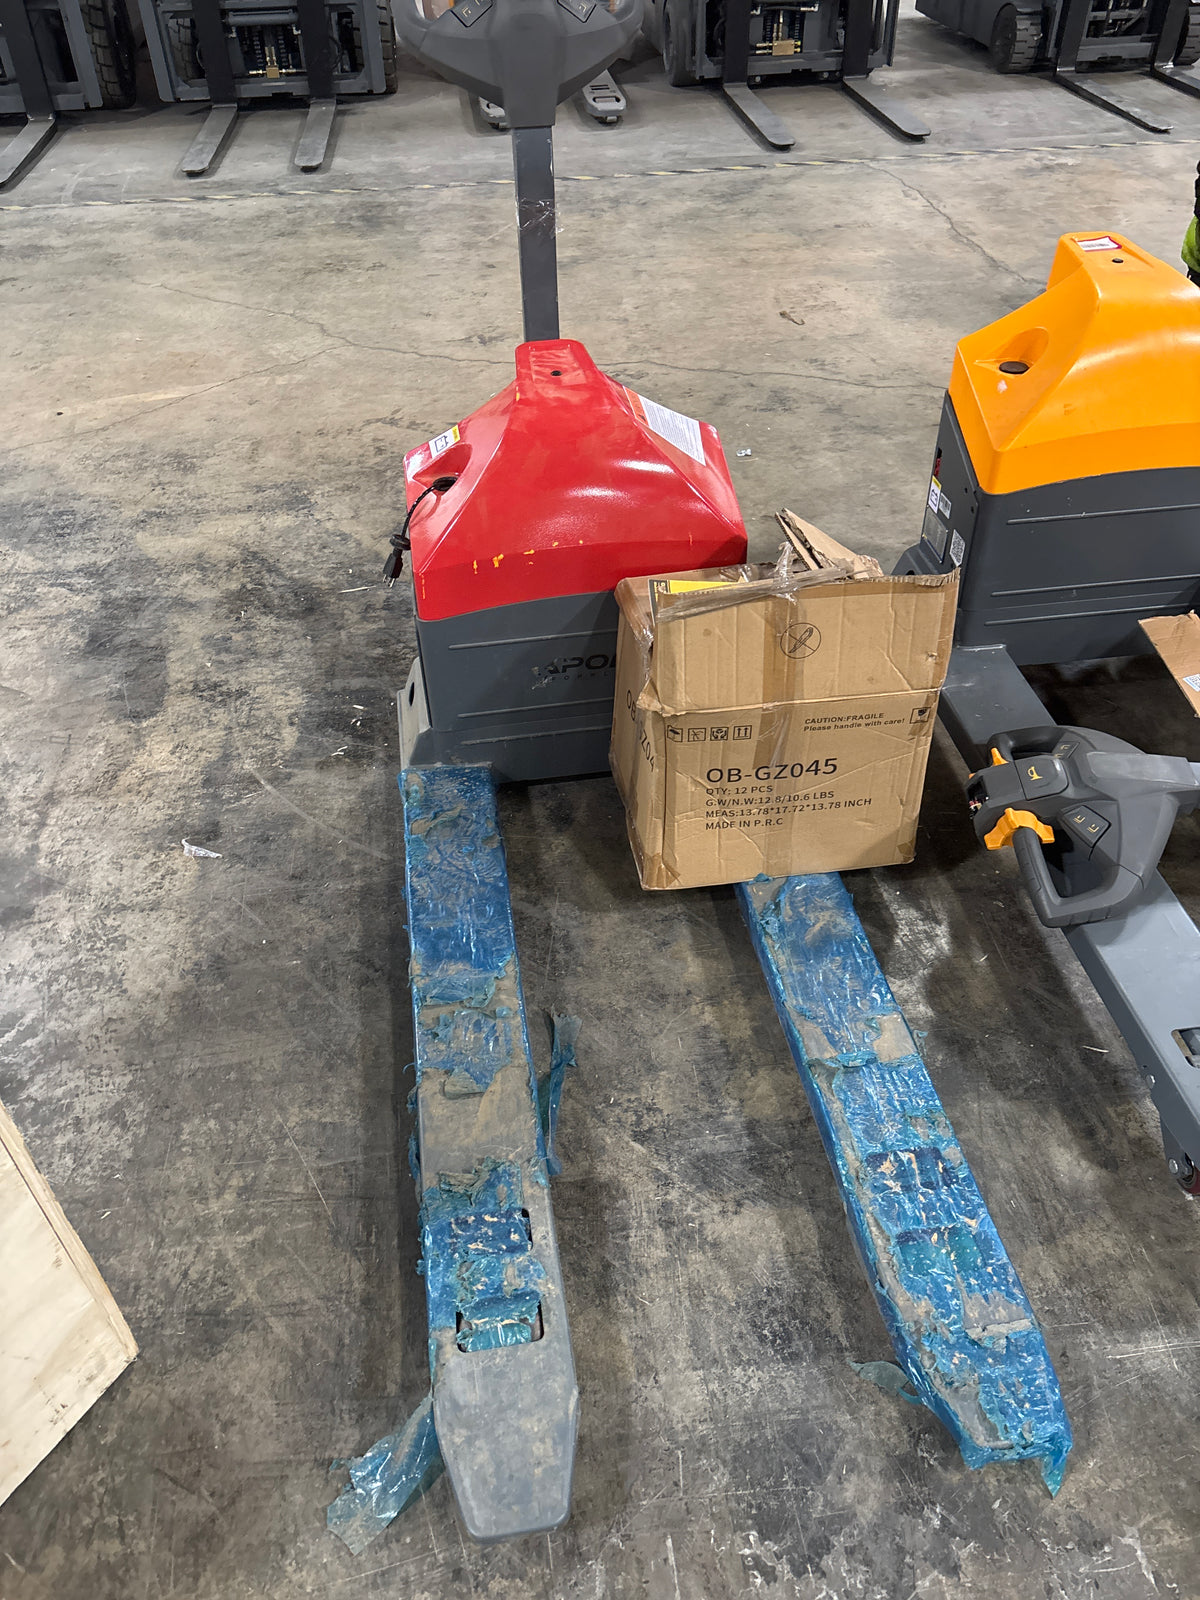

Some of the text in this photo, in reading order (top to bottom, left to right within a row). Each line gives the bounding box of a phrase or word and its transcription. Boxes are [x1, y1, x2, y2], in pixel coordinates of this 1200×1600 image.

[804, 712, 885, 725] CAUTION:FRAGILE
[833, 722, 862, 730] handle
[883, 718, 905, 726] care!
[706, 758, 837, 783] OB-GZ045
[705, 785, 773, 796] QTY: 12 PCS
[813, 790, 835, 800] LBS
[844, 797, 872, 808] INCH
[705, 817, 784, 831] MADE IN P.R.C
